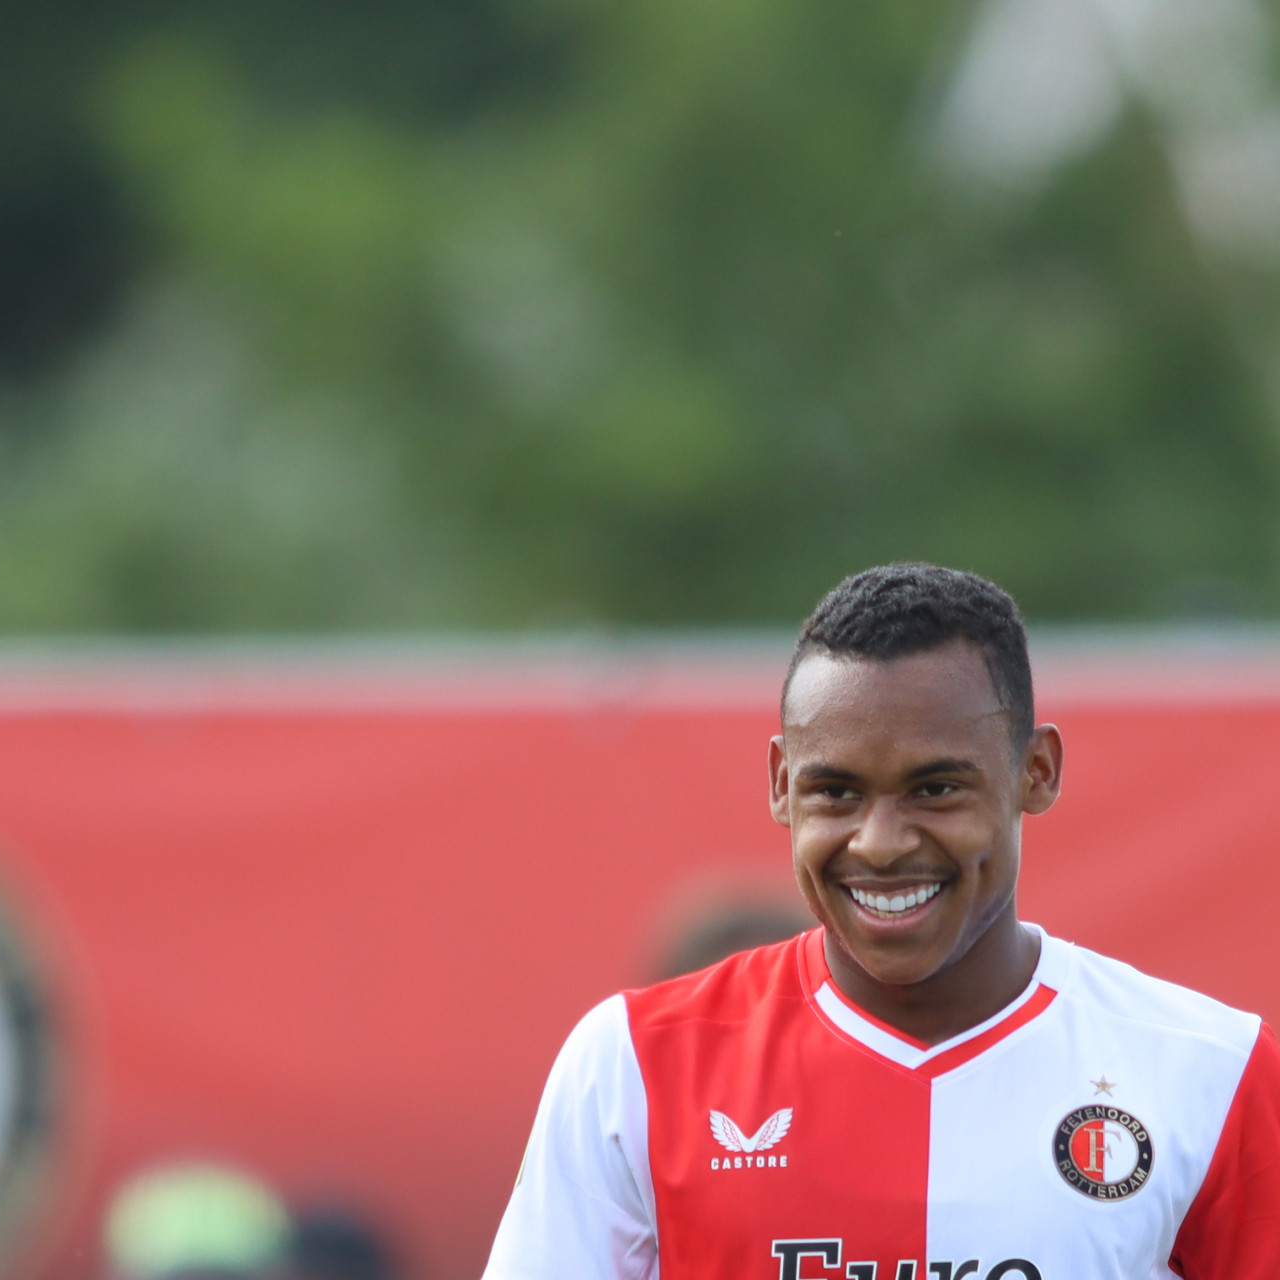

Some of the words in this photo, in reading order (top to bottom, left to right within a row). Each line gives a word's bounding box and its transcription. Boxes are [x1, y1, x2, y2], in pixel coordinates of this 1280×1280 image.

[1061, 1105, 1148, 1142] FEYENOORD
[710, 1155, 788, 1170] CASTORE
[1083, 1127, 1122, 1172] F
[1060, 1158, 1148, 1198] ROTTERDAM
